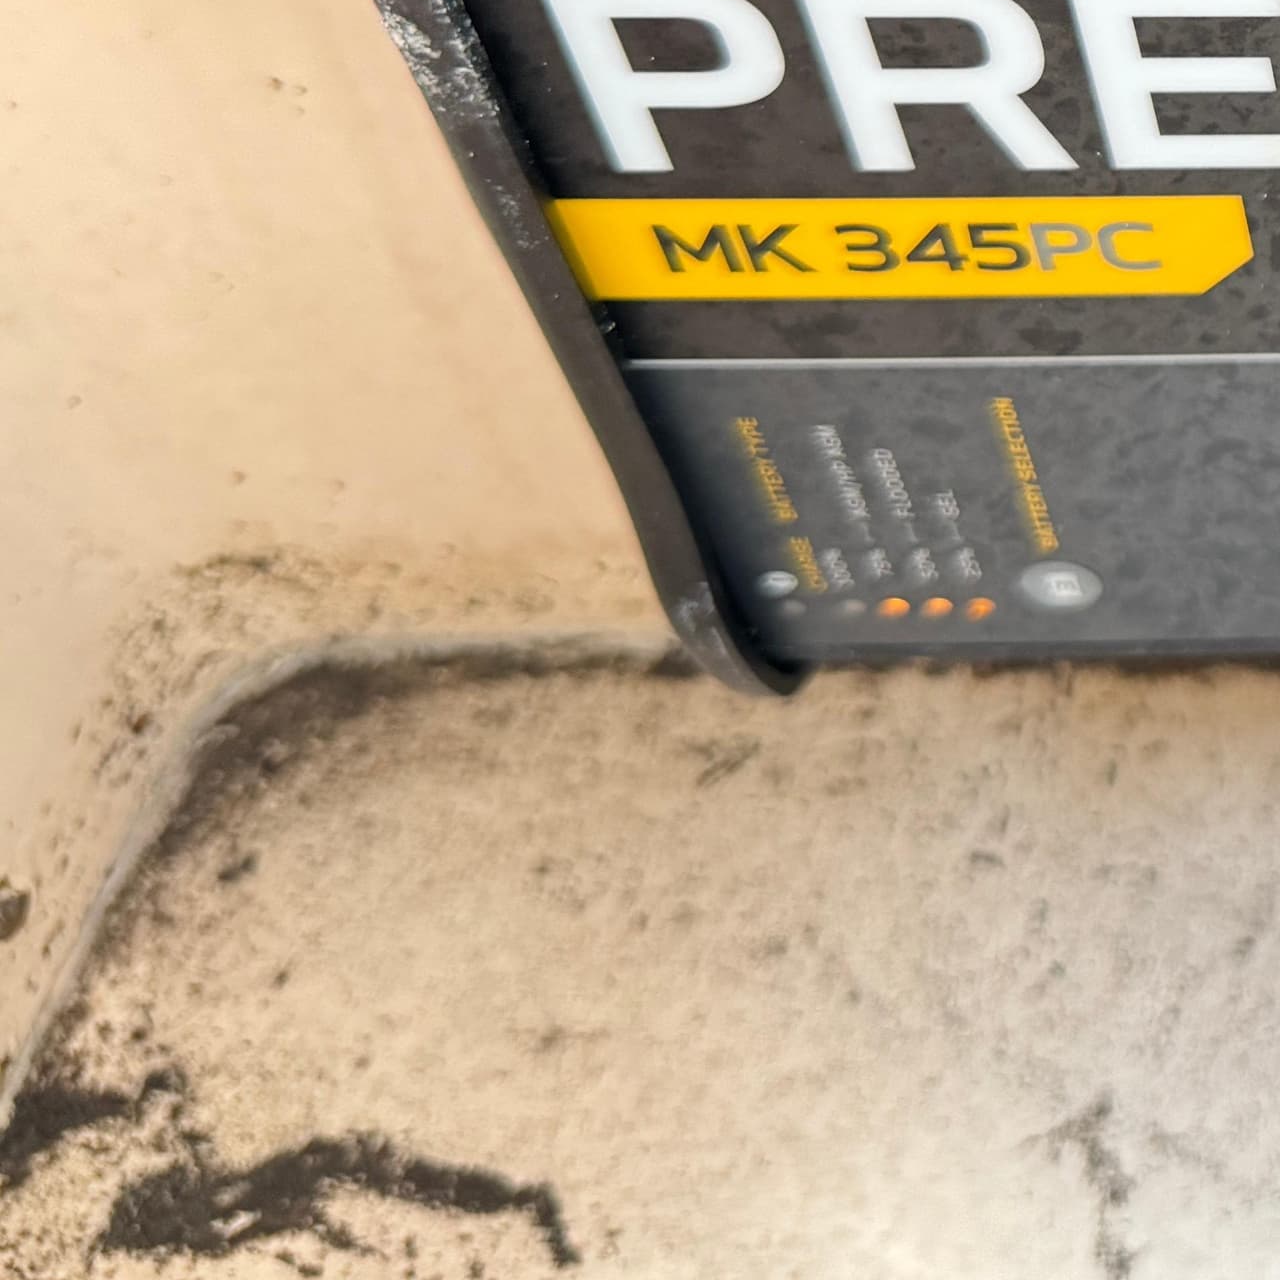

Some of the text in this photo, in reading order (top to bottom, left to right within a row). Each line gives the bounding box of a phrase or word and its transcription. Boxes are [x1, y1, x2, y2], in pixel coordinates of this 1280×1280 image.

[650, 221, 1163, 274] MK 345PC
[734, 417, 799, 522] BATTERY TYPE
[869, 448, 915, 518] FLOODED
[992, 397, 1059, 552] BATTERY SELECTION
